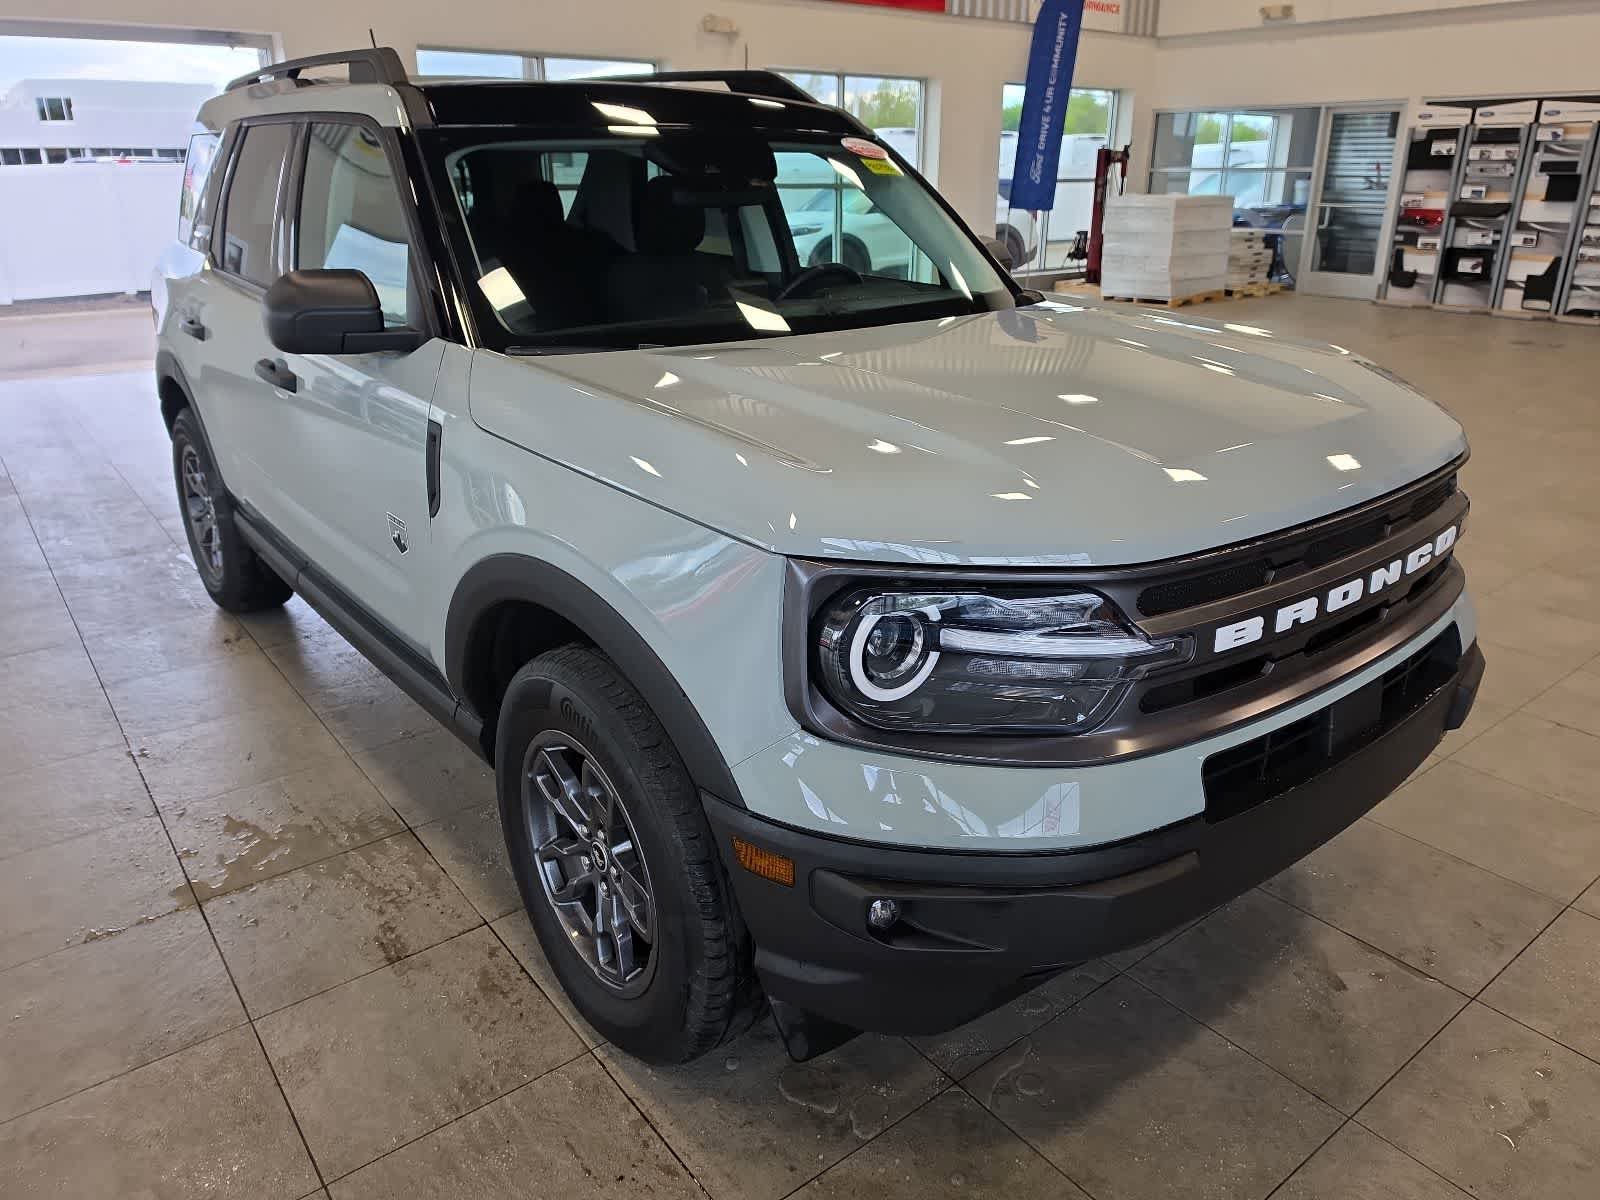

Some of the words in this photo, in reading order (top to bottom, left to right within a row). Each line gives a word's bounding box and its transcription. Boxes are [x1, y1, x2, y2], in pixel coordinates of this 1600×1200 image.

[1083, 0, 1121, 15] ORMANCE
[1029, 154, 1044, 185] Ford
[1038, 114, 1051, 150] DRIVE
[1045, 86, 1055, 104] UR
[1214, 525, 1457, 653] BRONCO
